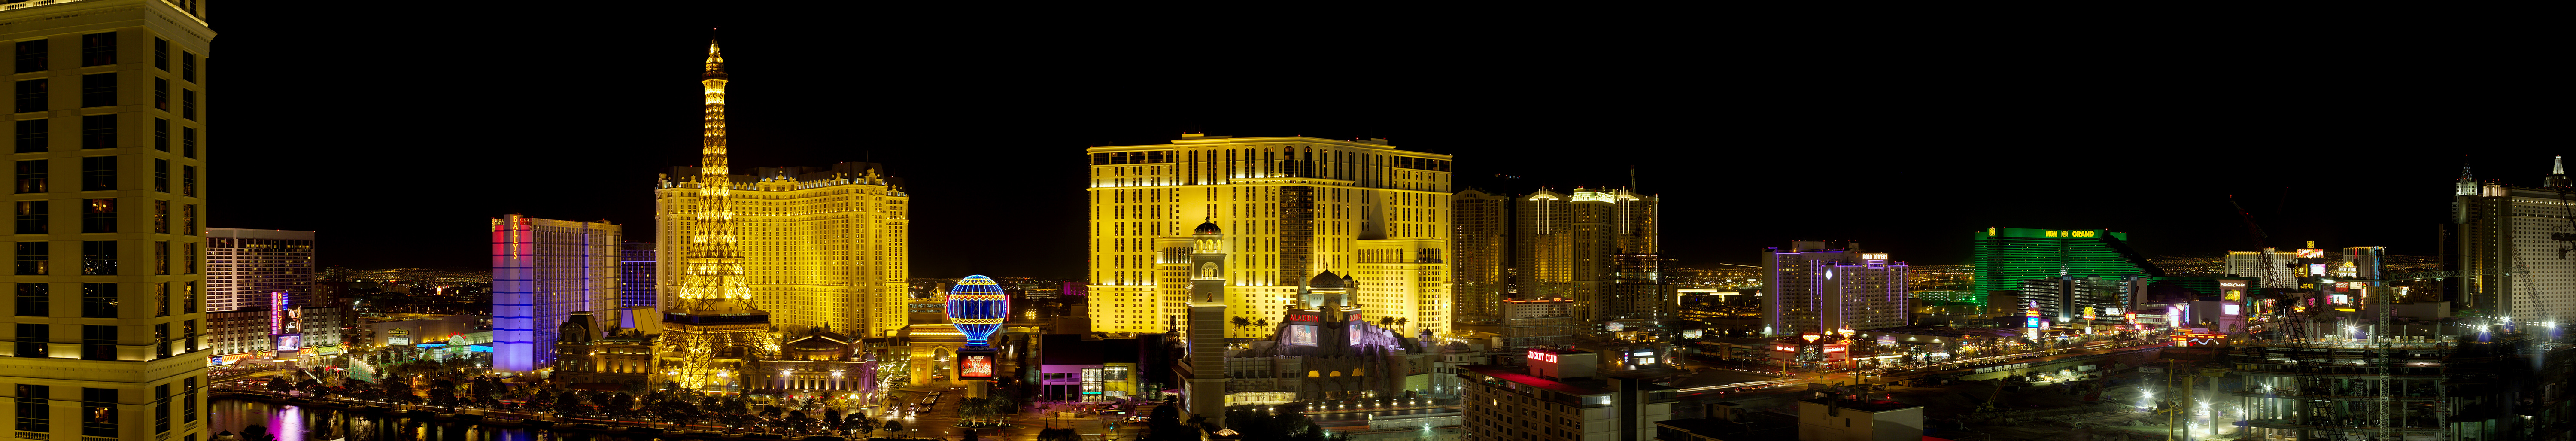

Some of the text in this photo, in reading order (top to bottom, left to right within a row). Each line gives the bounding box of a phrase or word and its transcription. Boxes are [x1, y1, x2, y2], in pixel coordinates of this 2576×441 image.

[2297, 248, 2324, 258] MGM
[1290, 314, 1318, 322] ALADDIN
[1349, 313, 1361, 322] ALADDIN
[447, 331, 466, 339] BALLYS
[1528, 351, 1557, 363] JOCKEY CLUB
